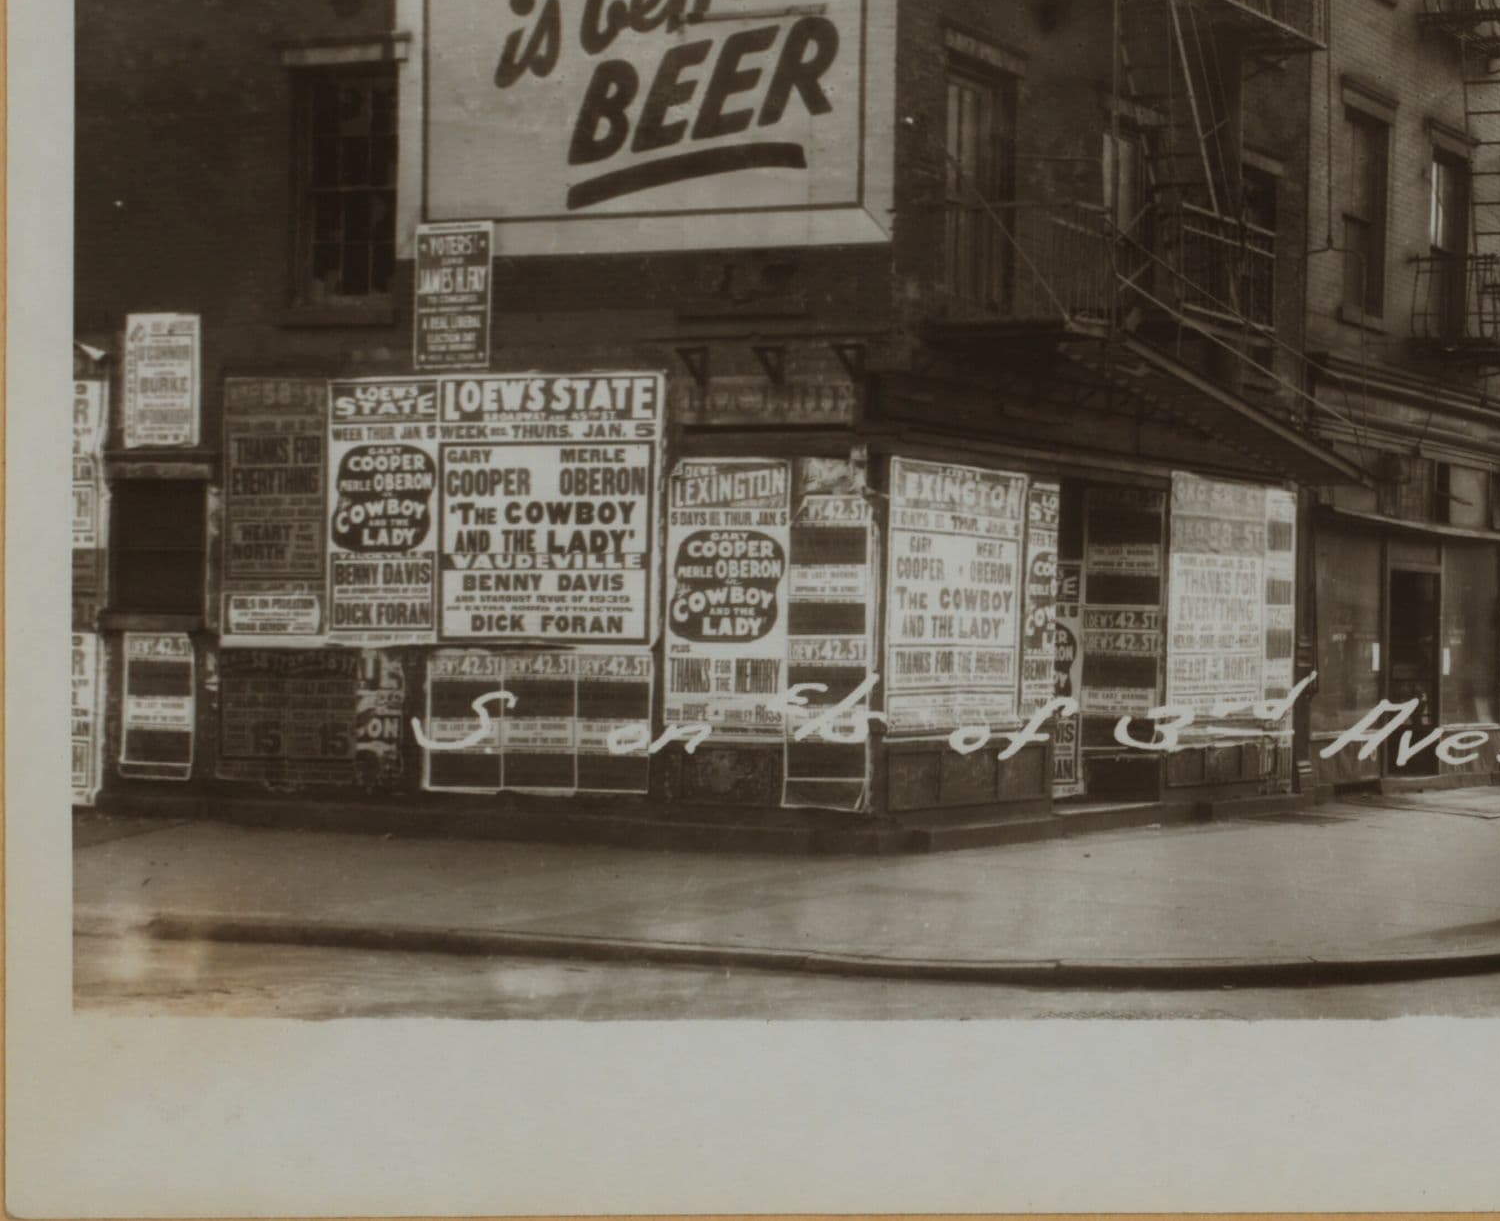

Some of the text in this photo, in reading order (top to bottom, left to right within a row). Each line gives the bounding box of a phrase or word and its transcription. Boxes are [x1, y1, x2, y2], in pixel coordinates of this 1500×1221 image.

[566, 16, 840, 166] BEER
[335, 392, 437, 416] STATE
[550, 377, 654, 419] STATE
[440, 424, 488, 440] WEEK
[583, 423, 626, 438] JAN.
[635, 423, 655, 438] 5
[348, 454, 426, 472] COOPER
[447, 449, 493, 463] GARY
[559, 448, 626, 463] MERLE
[373, 473, 432, 492] OBERON
[446, 468, 531, 497] COOPER
[559, 467, 646, 496] OBERON
[675, 467, 785, 507] LEXINGTON
[336, 498, 425, 533] COWBOY
[505, 500, 637, 525] COWBOY
[362, 528, 416, 546] LADY
[454, 530, 491, 553] AND
[501, 529, 536, 552] THE
[710, 532, 749, 541] GARY
[687, 540, 774, 558] COOPER
[450, 553, 643, 570] VAUDEVILLE
[677, 559, 782, 578] MERLE OBERON
[896, 557, 945, 580] COOPER
[969, 560, 1012, 585] OBERON
[334, 563, 431, 585] BENNY DAVIS
[462, 574, 624, 592] BENNY DAVIS
[673, 586, 774, 622] COWBOY
[939, 587, 1013, 613] COWBOY
[334, 603, 431, 626] DICK FORAN
[471, 615, 623, 634] DICK FORAN
[901, 616, 924, 638] AND
[931, 615, 955, 639] THE
[670, 658, 711, 693] THANKS
